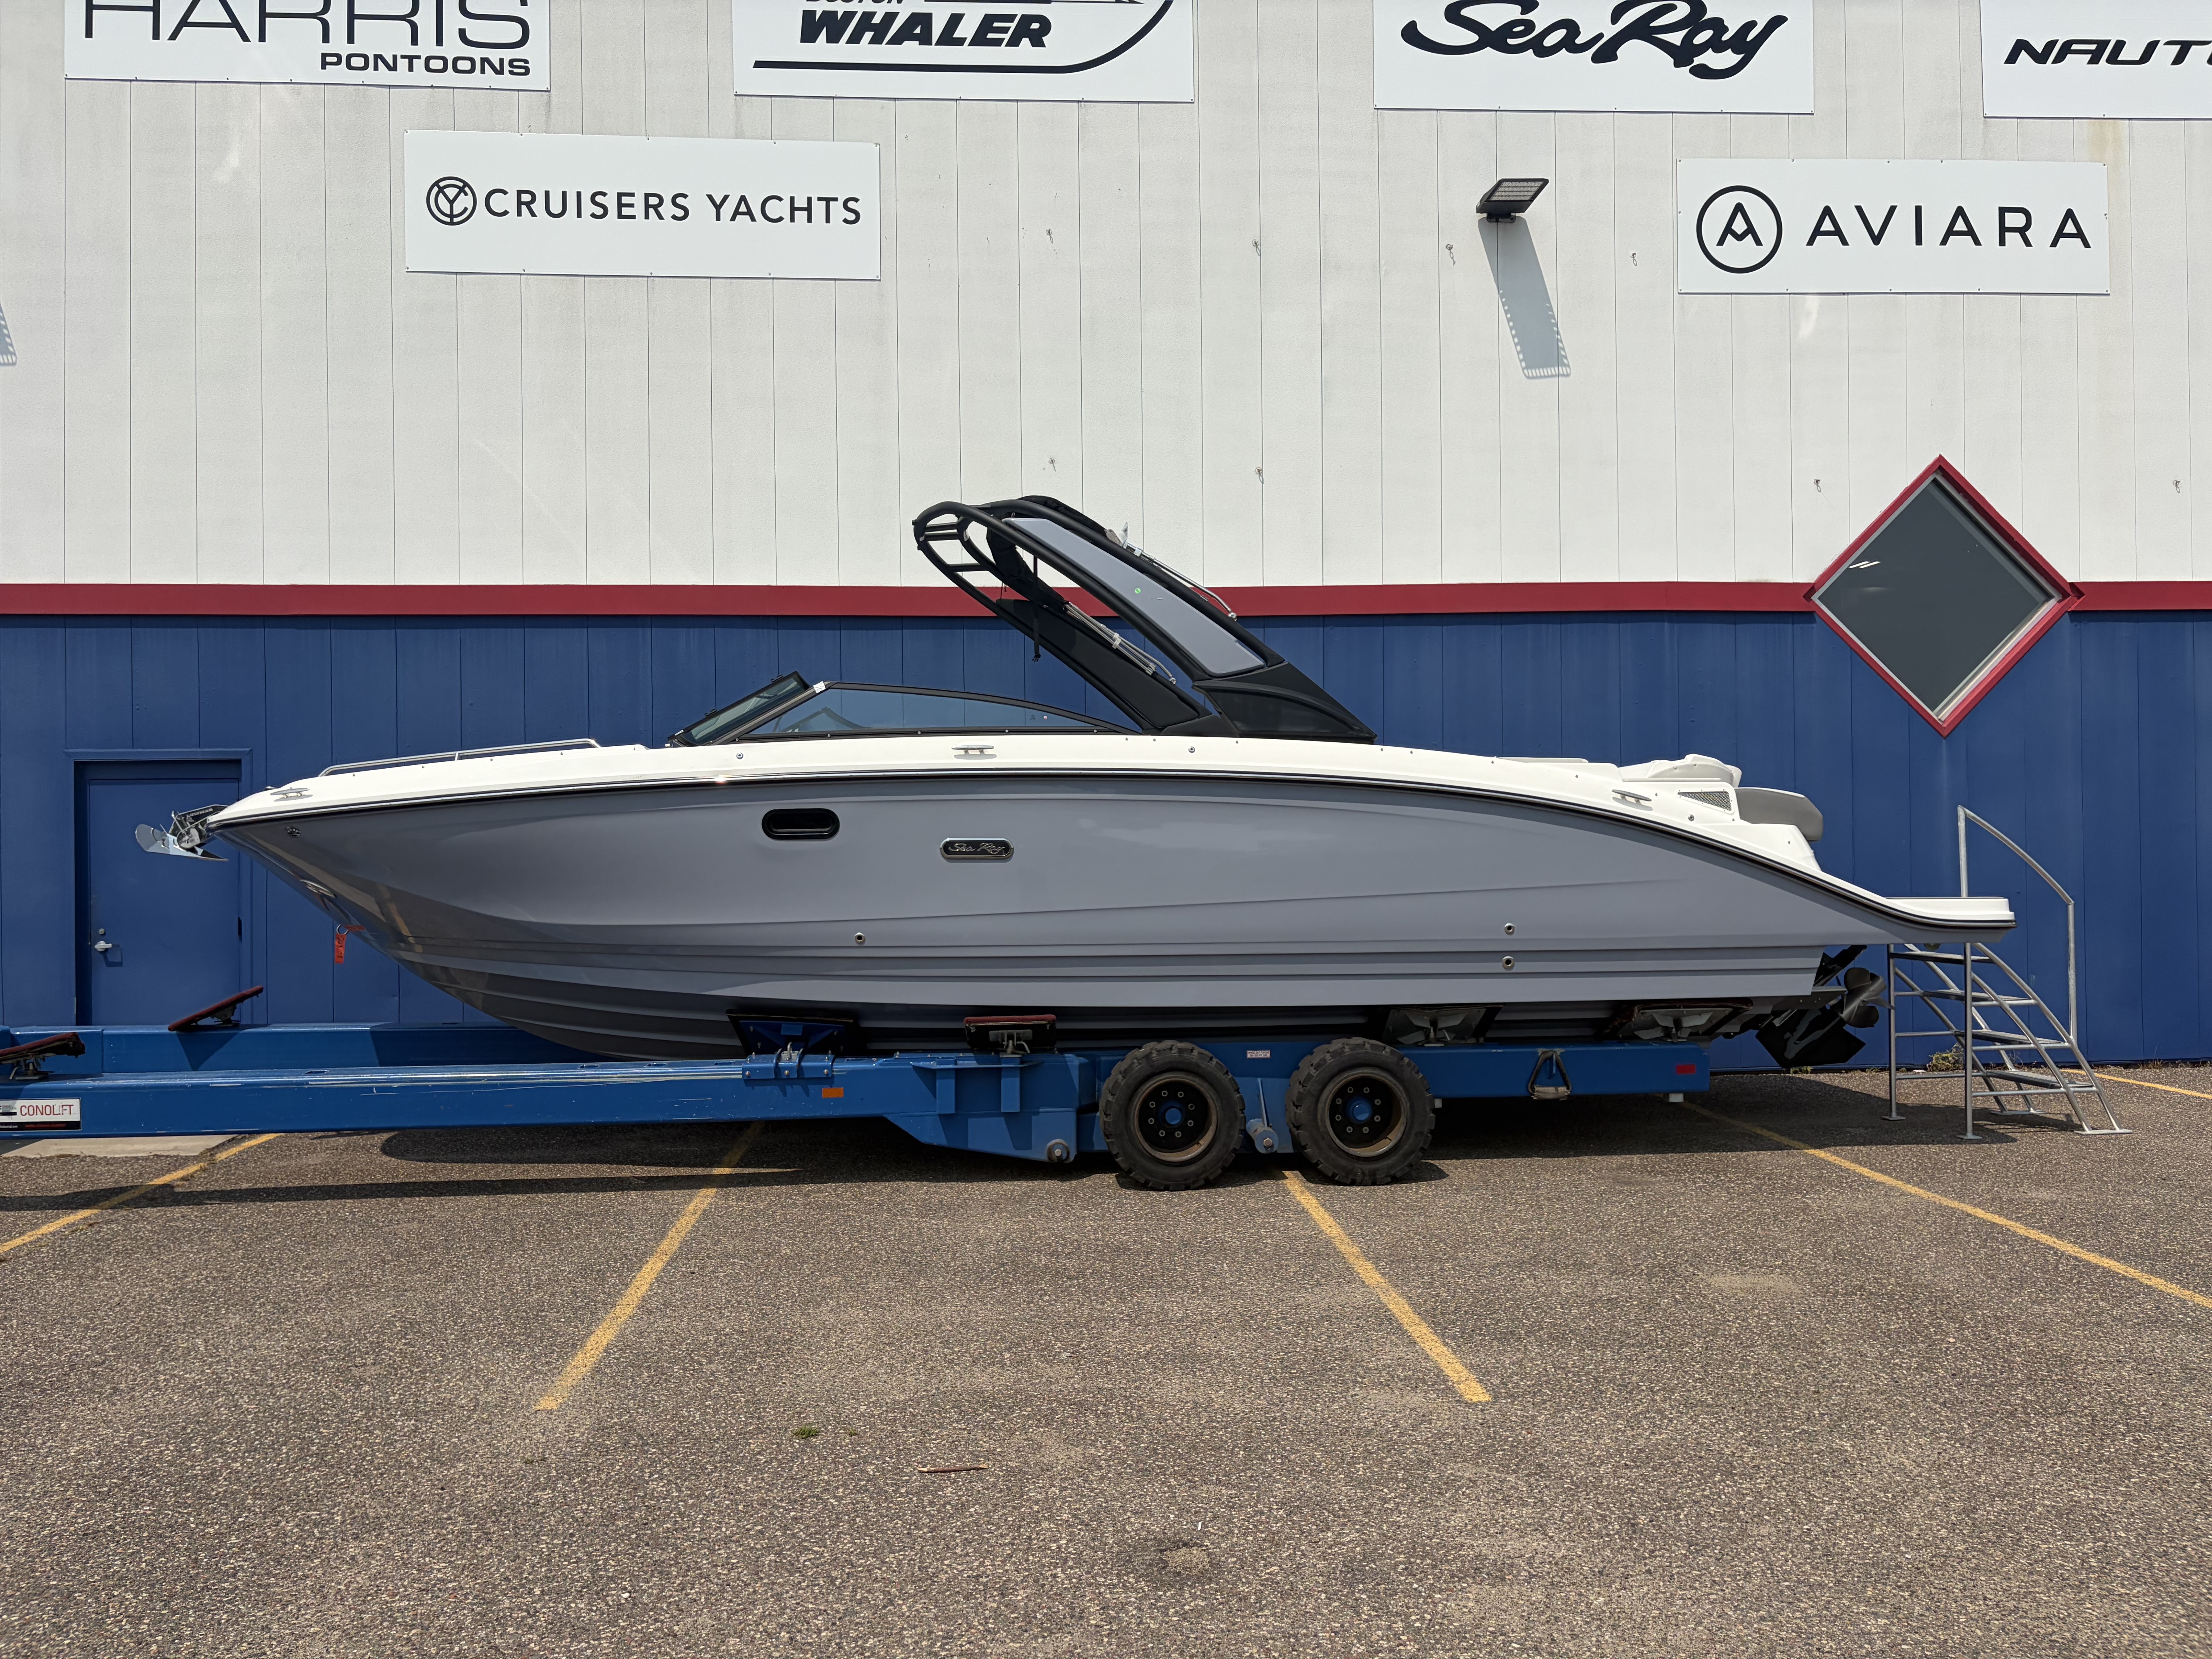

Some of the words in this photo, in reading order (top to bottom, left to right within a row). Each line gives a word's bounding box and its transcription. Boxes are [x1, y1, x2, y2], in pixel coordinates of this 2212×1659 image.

[85, 0, 530, 49] HARRIS
[800, 10, 1052, 48] WHALER
[1401, 0, 1604, 58] Sea
[1591, 0, 1788, 80] Ray
[321, 53, 530, 76] PONTOONS
[484, 188, 689, 221] CRUISERS
[706, 194, 860, 225] YACHTS
[1806, 205, 2091, 249] AVIARA
[948, 843, 976, 852] Sea
[977, 842, 1006, 854] Ray
